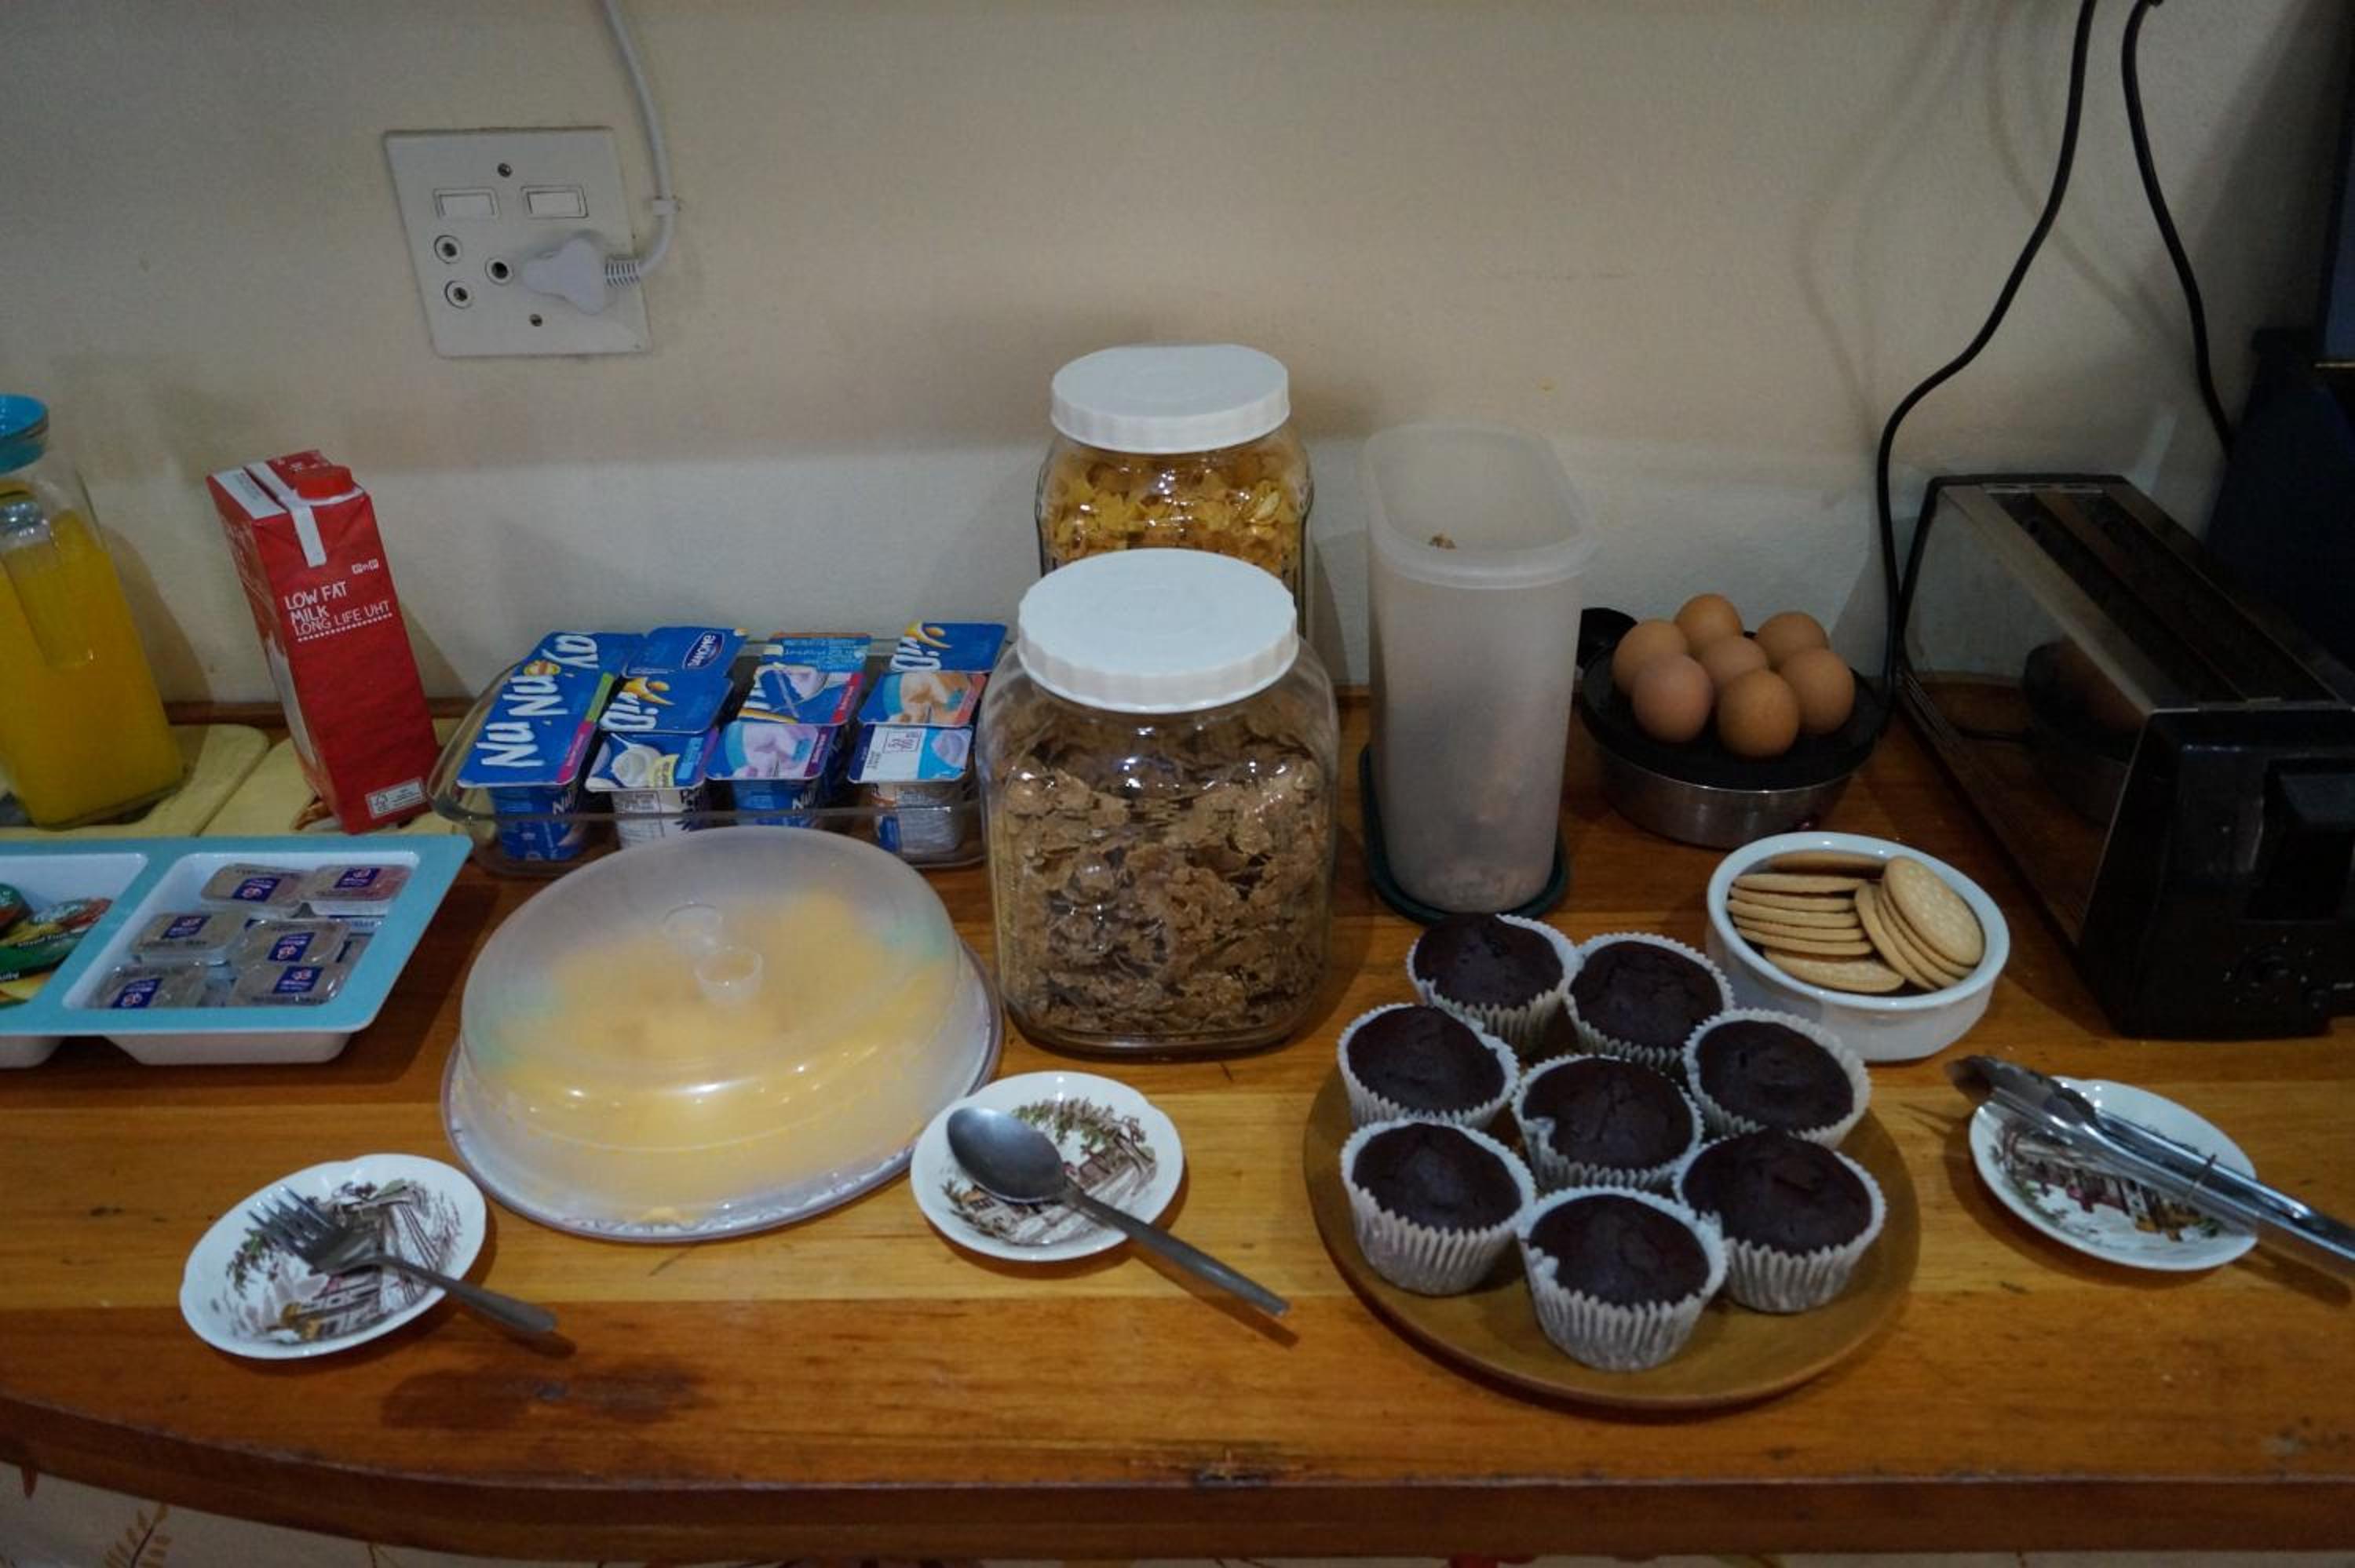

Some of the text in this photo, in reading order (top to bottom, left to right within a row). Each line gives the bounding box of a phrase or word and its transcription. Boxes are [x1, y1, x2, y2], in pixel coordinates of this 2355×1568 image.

[284, 581, 347, 610] LOW FAT
[290, 605, 330, 624] MILK
[292, 600, 390, 636] LONG LIFE UHT
